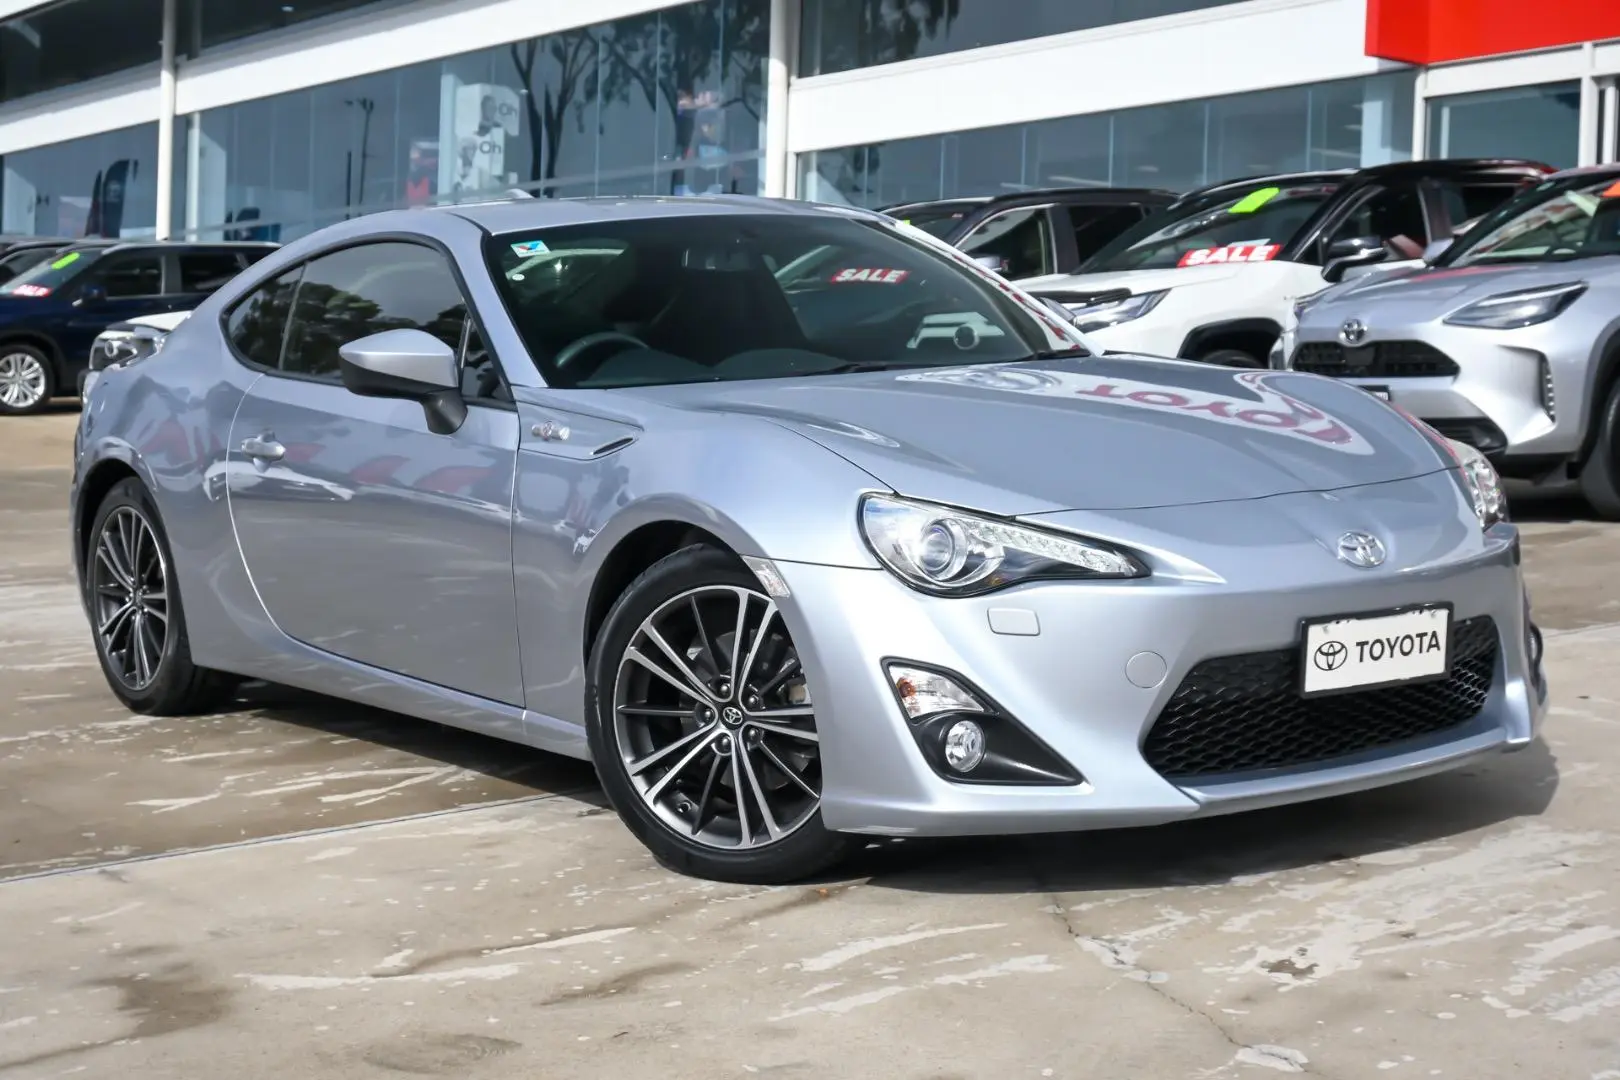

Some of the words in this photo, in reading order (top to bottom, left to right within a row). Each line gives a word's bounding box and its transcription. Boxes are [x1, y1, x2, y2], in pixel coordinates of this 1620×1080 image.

[479, 141, 502, 154] Oh
[1185, 245, 1276, 266] SALE
[835, 268, 906, 283] SALE
[1355, 630, 1441, 663] TOYOTA
